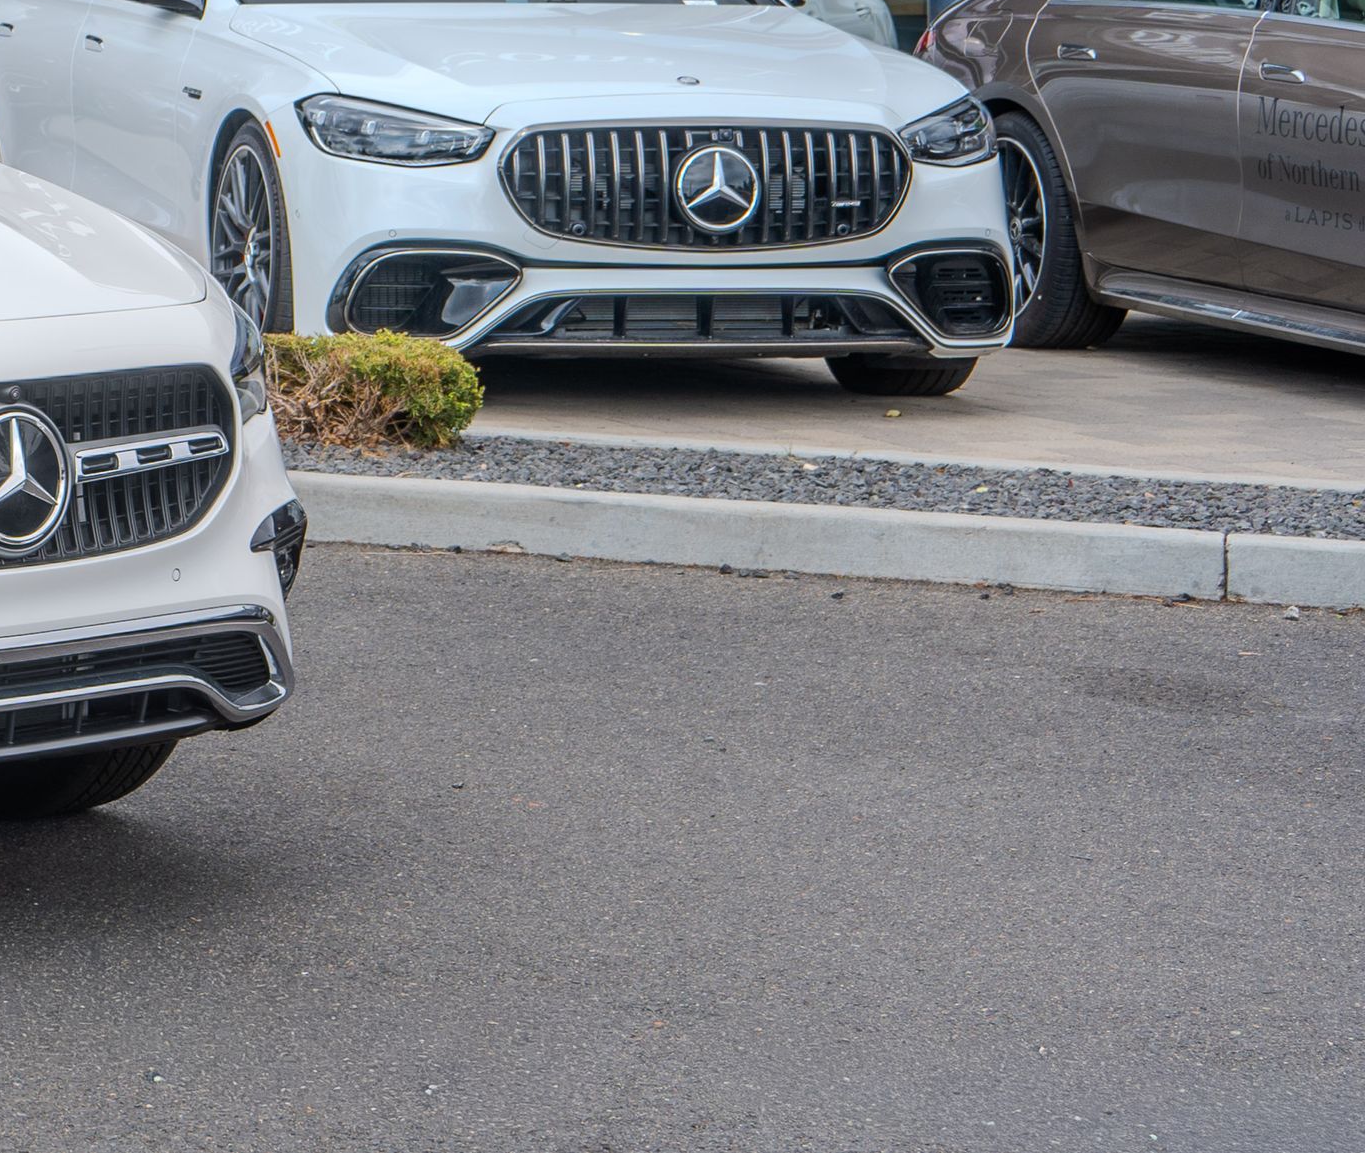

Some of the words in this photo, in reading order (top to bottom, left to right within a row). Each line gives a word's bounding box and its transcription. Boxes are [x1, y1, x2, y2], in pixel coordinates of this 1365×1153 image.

[1257, 153, 1275, 180] of
[1279, 155, 1361, 192] Northern
[1295, 207, 1354, 230] LAPIS
